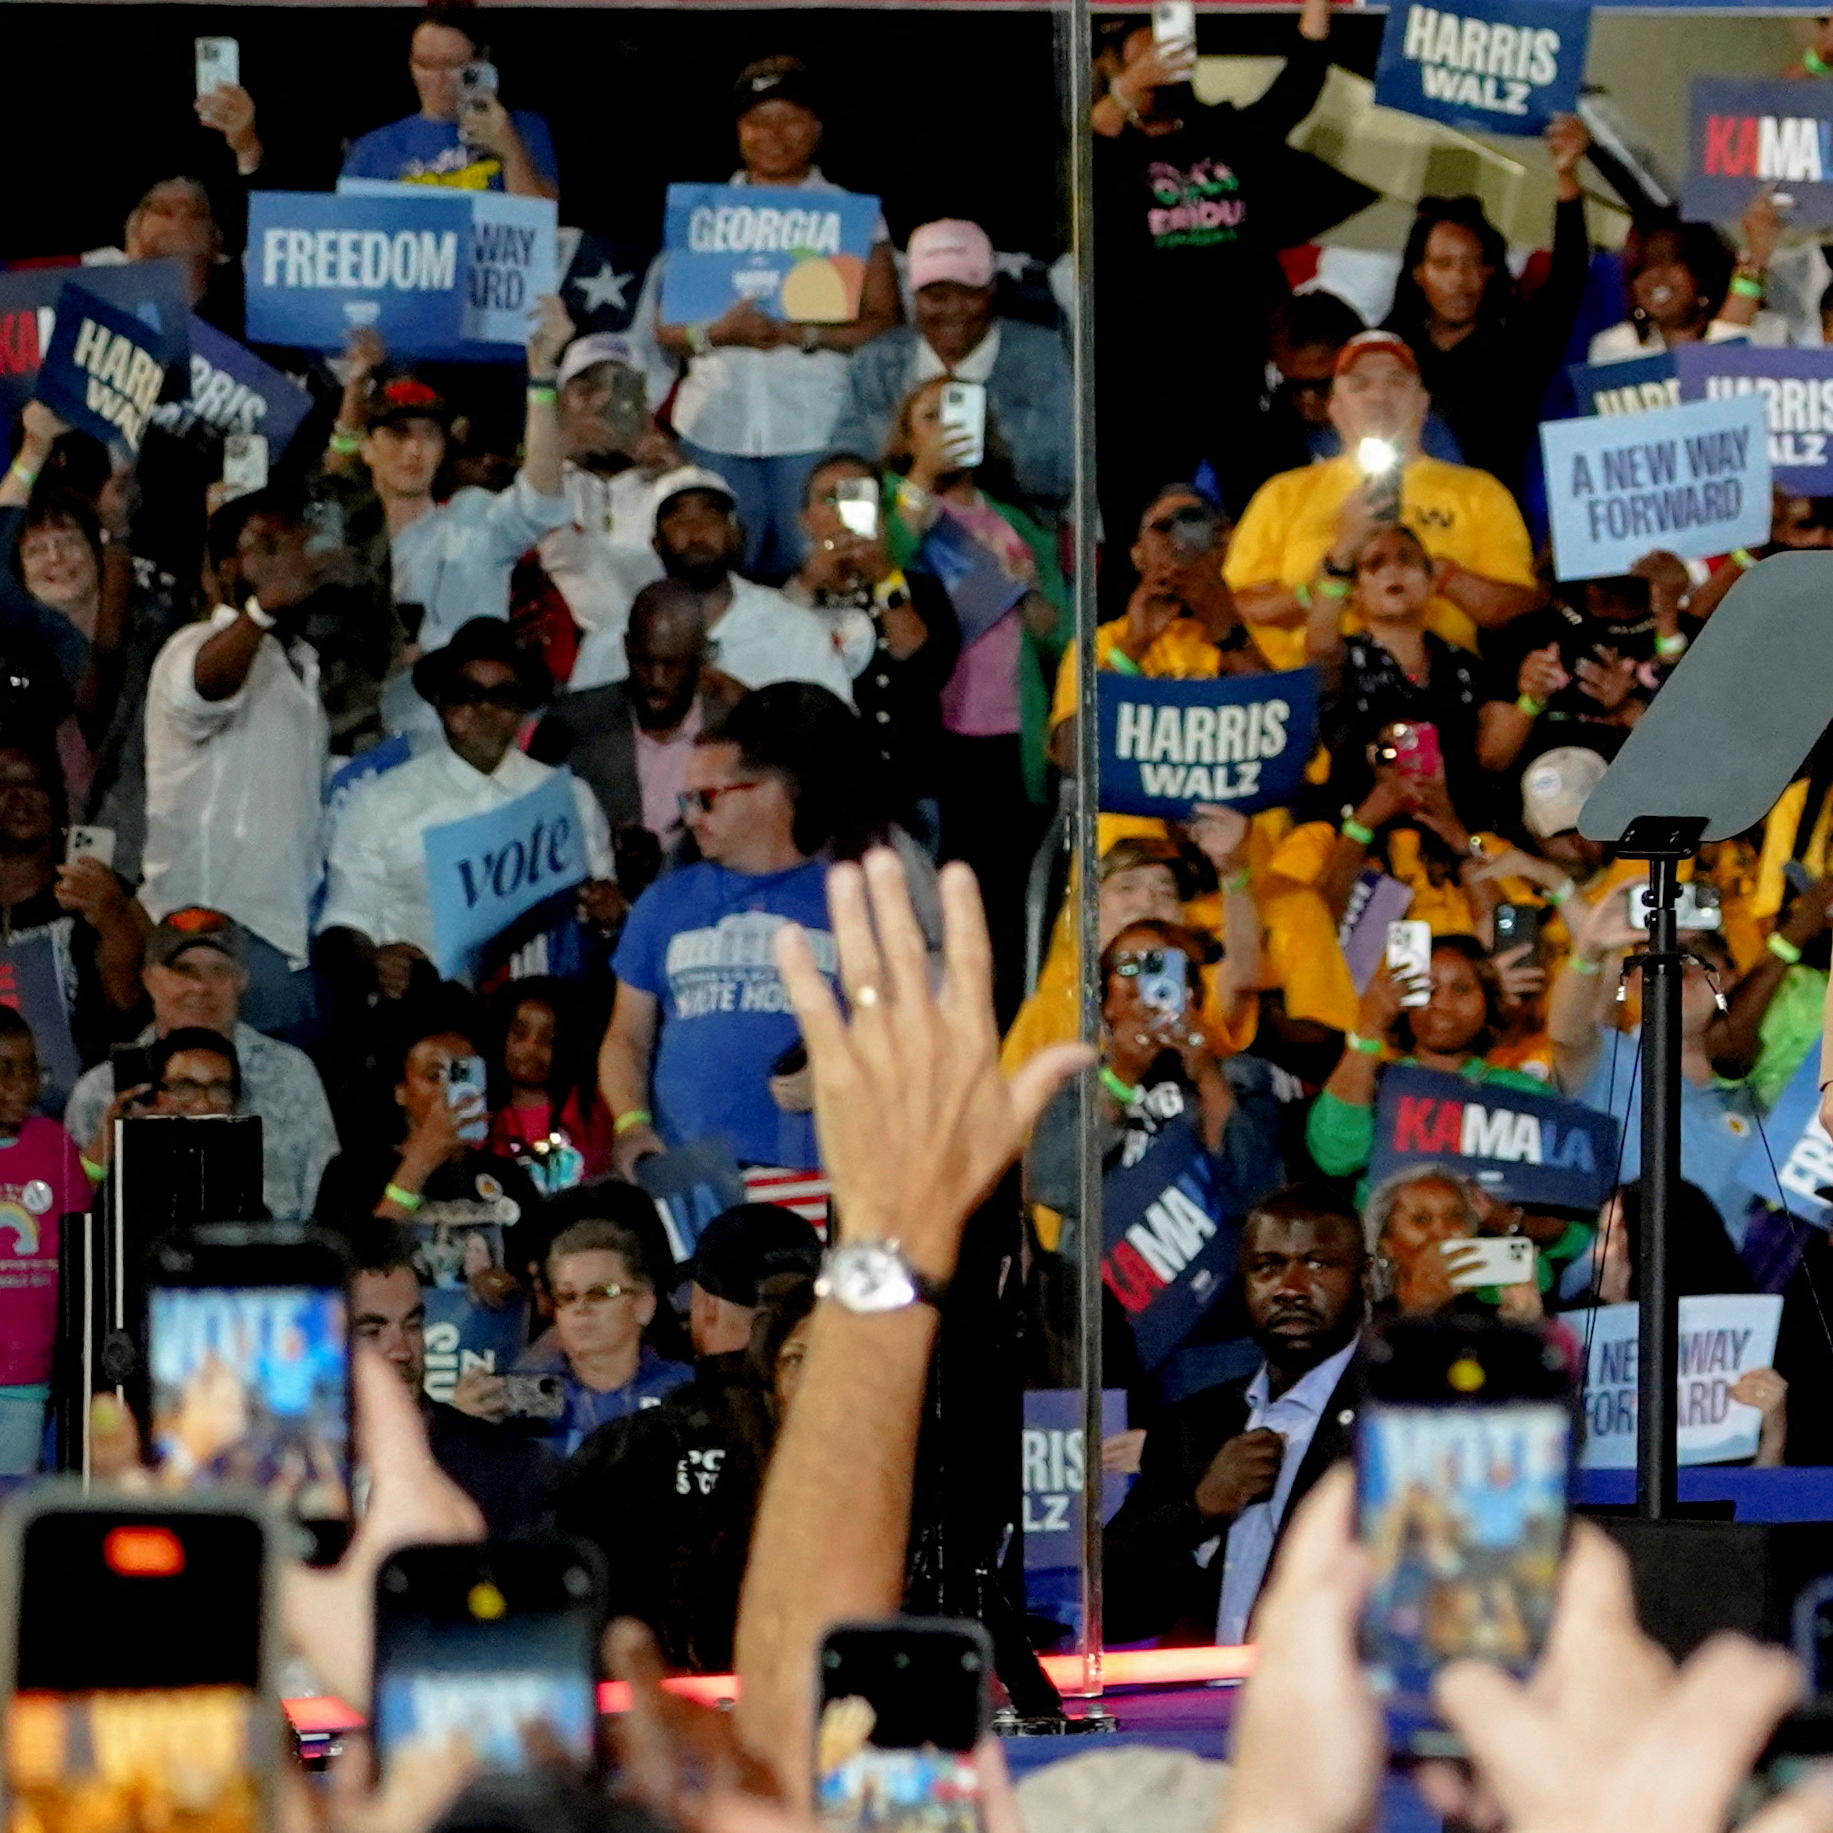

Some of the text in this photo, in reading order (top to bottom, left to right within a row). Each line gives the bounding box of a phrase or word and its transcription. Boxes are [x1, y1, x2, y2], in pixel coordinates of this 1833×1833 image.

[1403, 3, 1561, 87] HARRIS
[1421, 63, 1534, 117] WALZ
[263, 228, 459, 292] FREEDOM
[688, 204, 842, 254] GEORGIA
[1571, 424, 1751, 499] A NEW WAY
[1588, 477, 1743, 543] FORWARD
[1115, 698, 1291, 765] HARRIS
[1140, 760, 1263, 801] WALZ
[455, 812, 571, 909] vote
[1394, 1094, 1601, 1176] KAMALA
